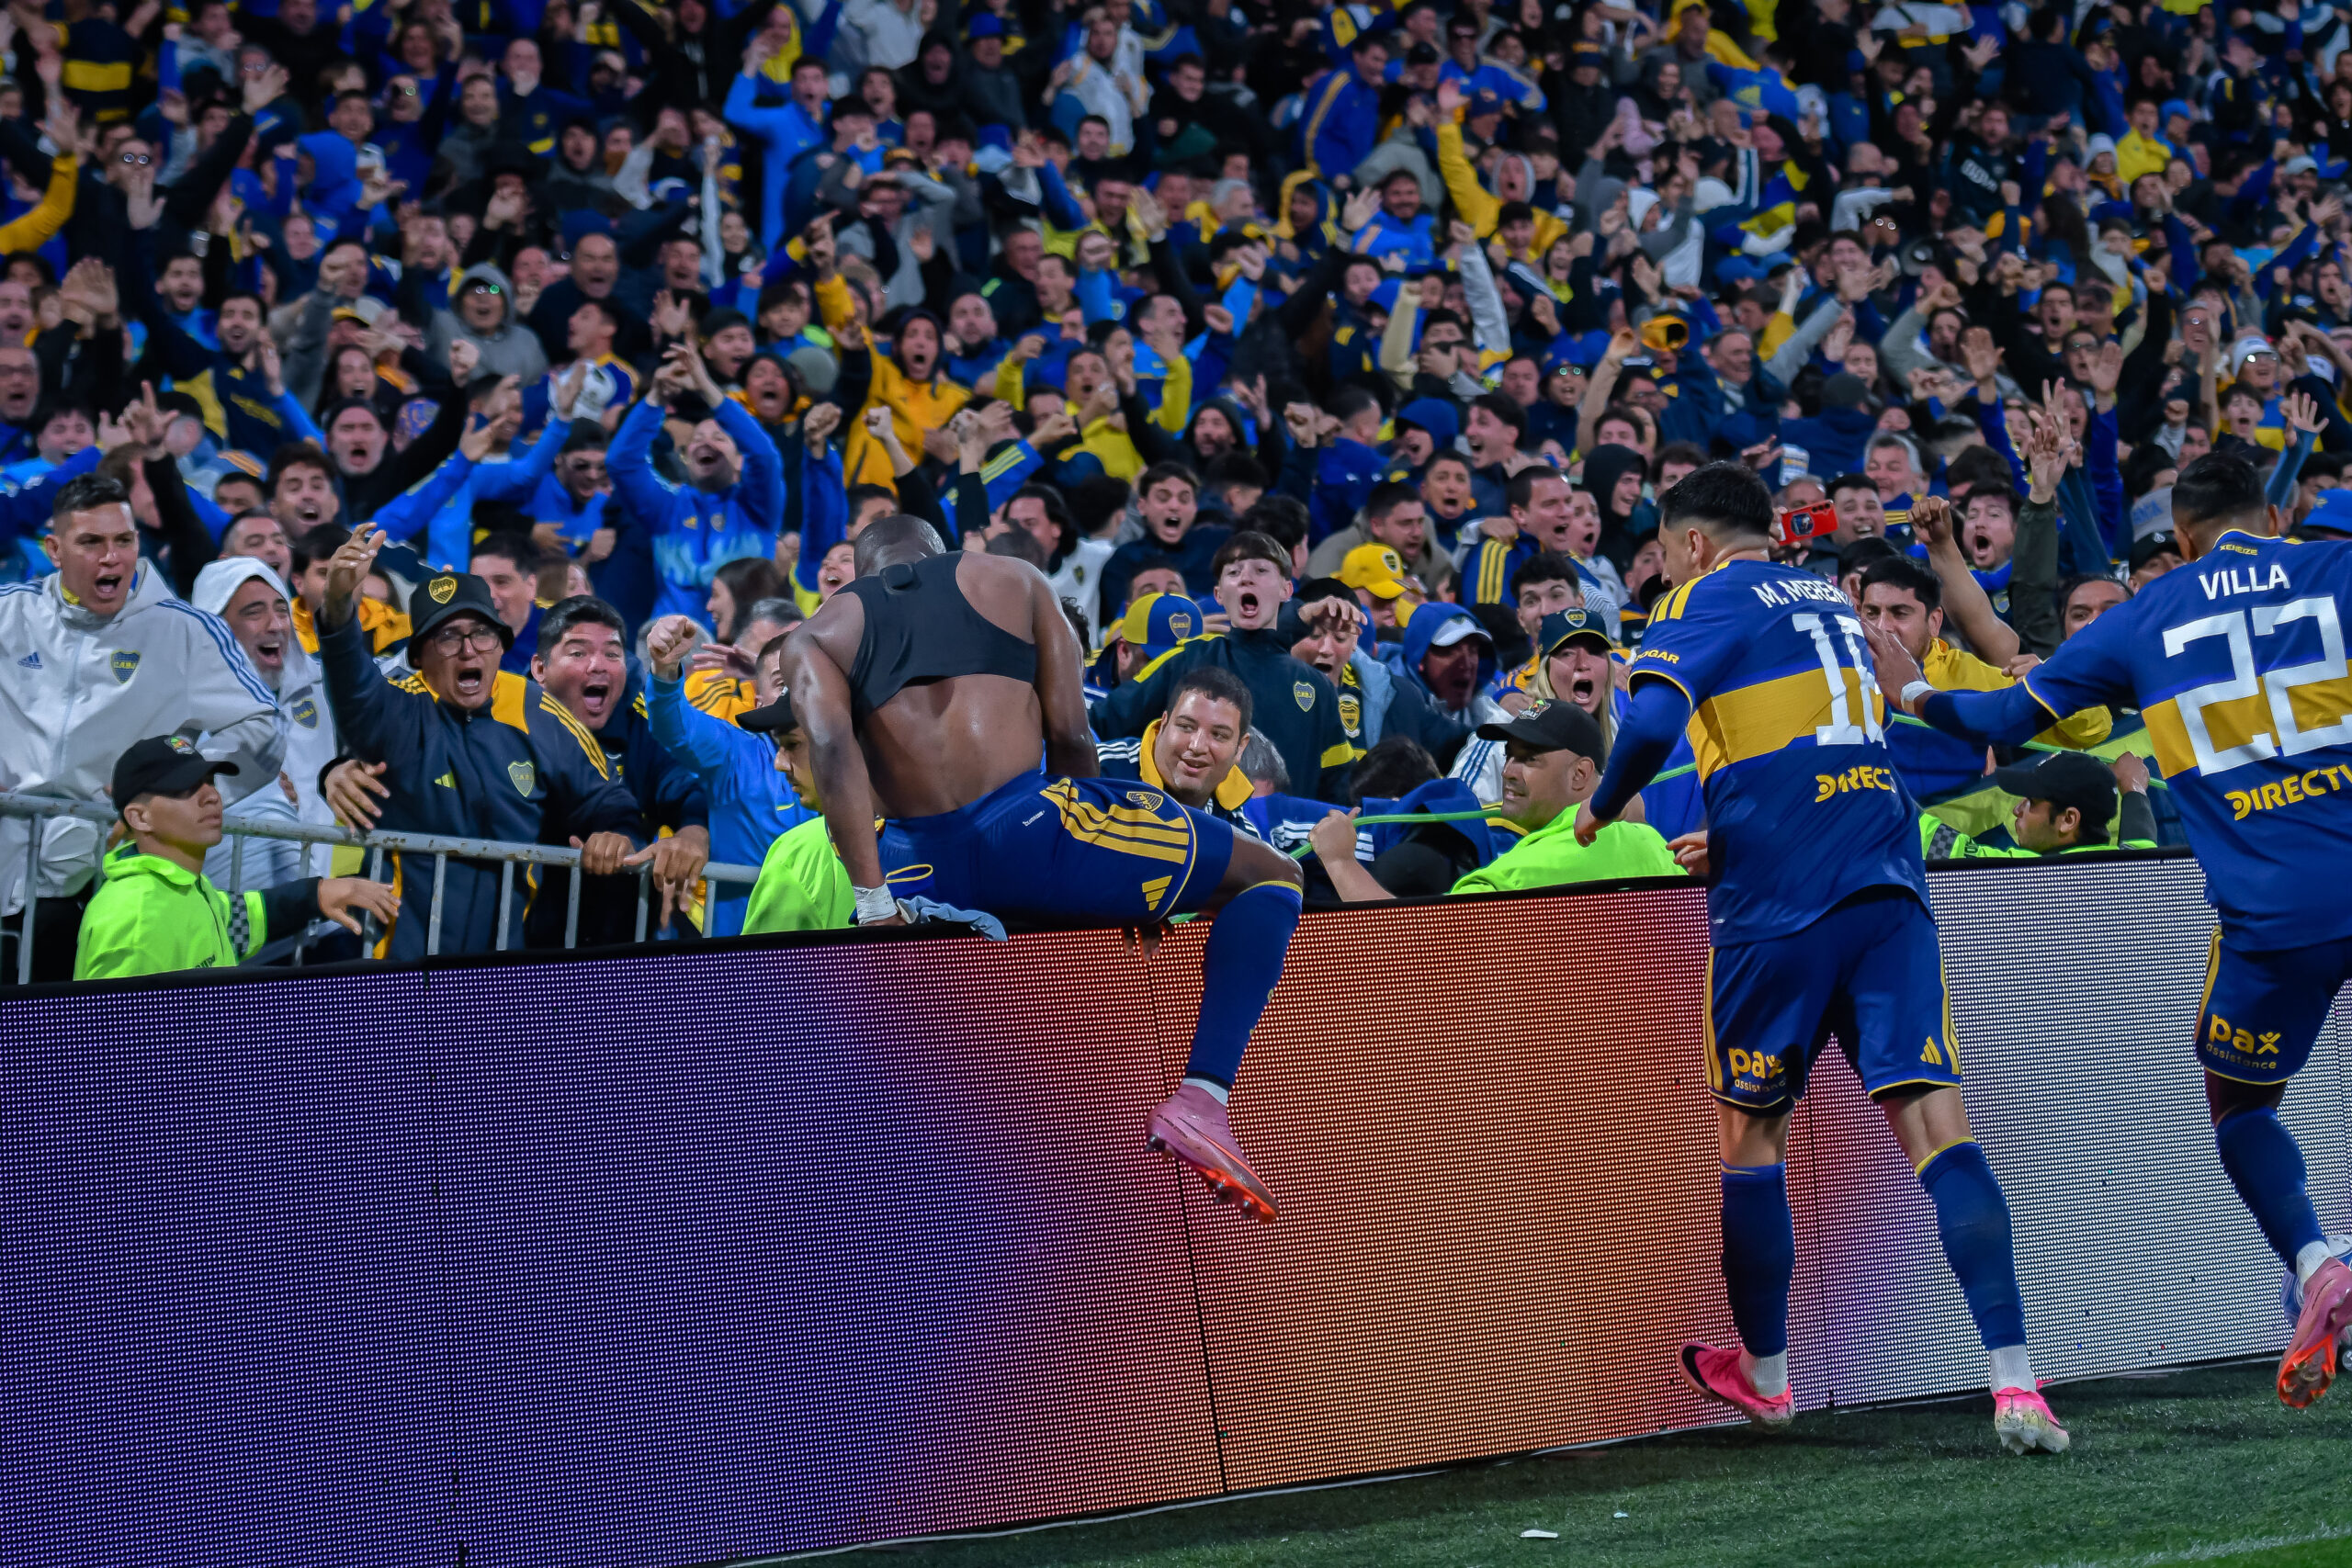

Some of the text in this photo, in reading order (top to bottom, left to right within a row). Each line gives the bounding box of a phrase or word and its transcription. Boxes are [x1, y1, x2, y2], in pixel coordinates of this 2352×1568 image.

[1750, 582, 1790, 608] M.
[2199, 564, 2291, 600] VILLA
[2162, 596, 2352, 777] 22
[2209, 1014, 2281, 1055] pax
[1728, 1048, 1785, 1079] pax
[2206, 1043, 2277, 1069] assistance
[1735, 1078, 1786, 1093] assistanc
